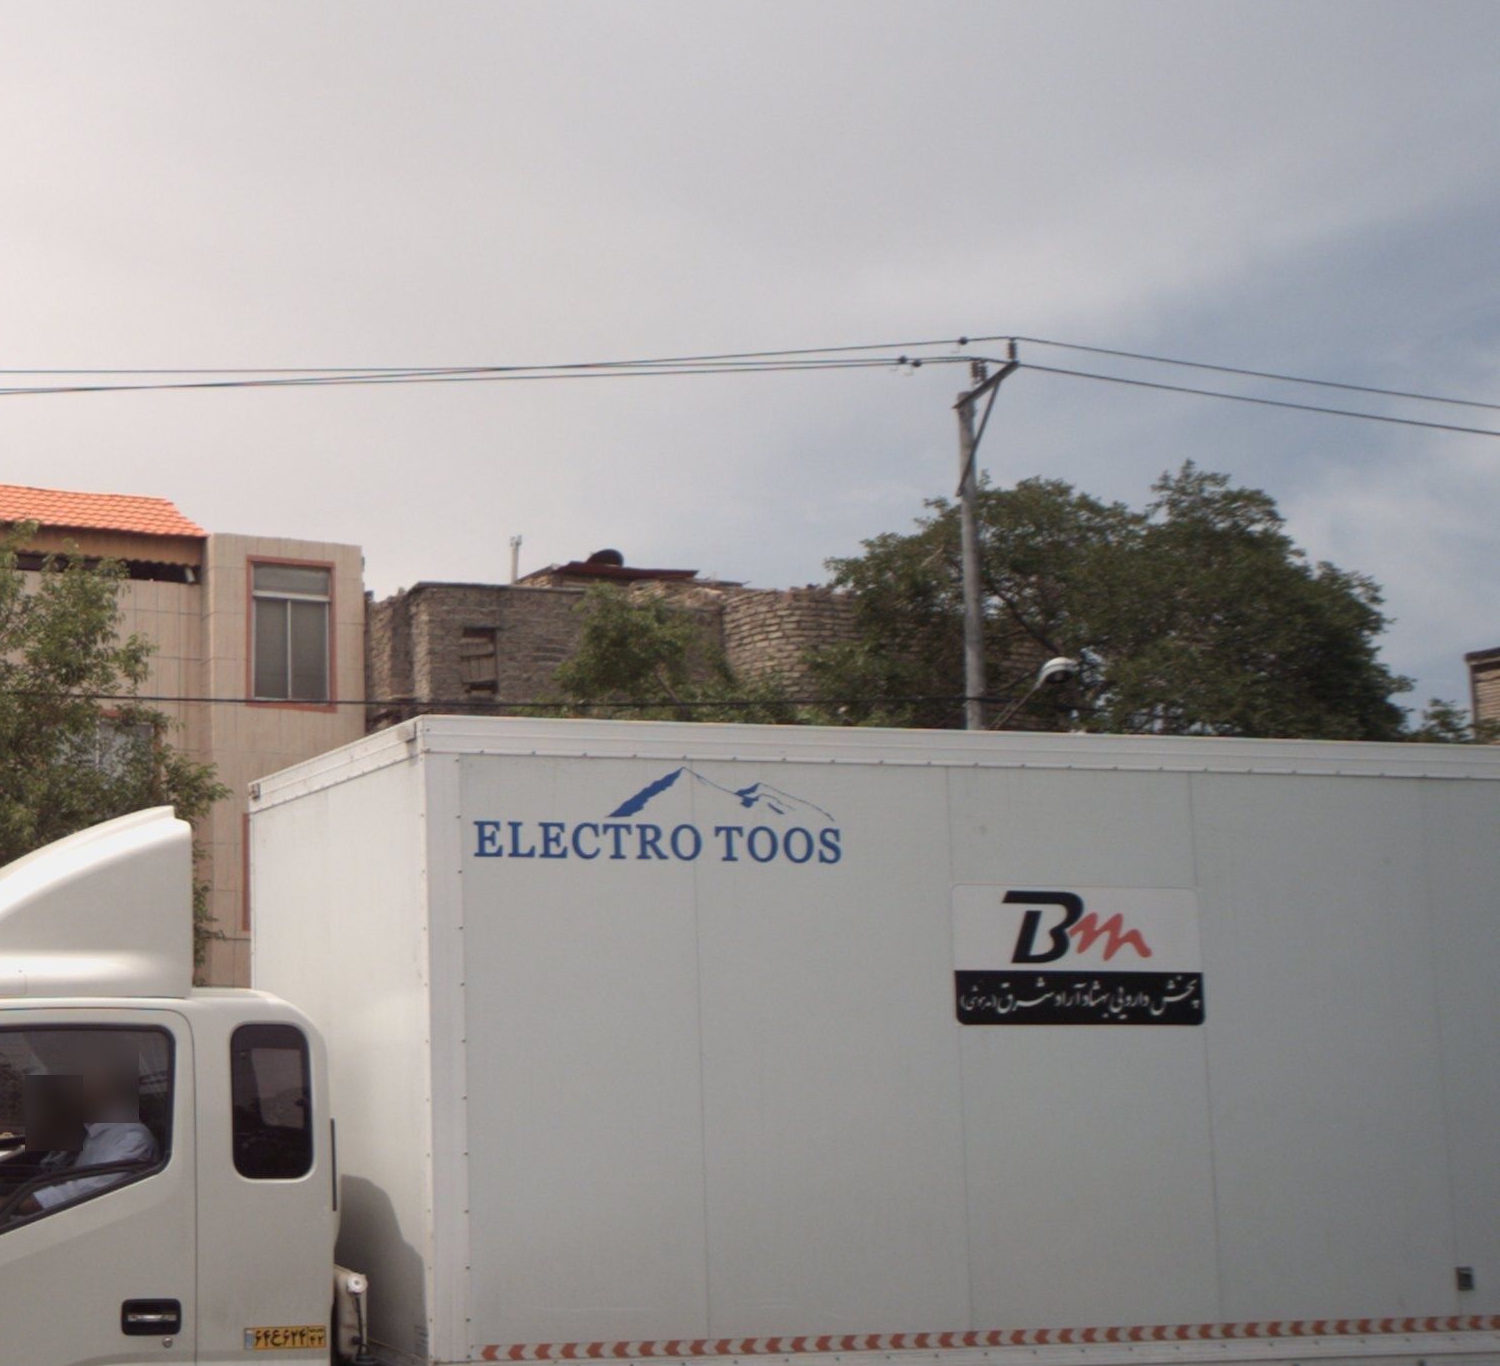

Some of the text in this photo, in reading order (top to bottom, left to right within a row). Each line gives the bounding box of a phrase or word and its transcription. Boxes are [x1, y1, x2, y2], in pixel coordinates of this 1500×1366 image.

[473, 820, 843, 865] ELECTRO TOOS
[996, 976, 1056, 1015] شرق
[1149, 975, 1201, 1016] پخش
